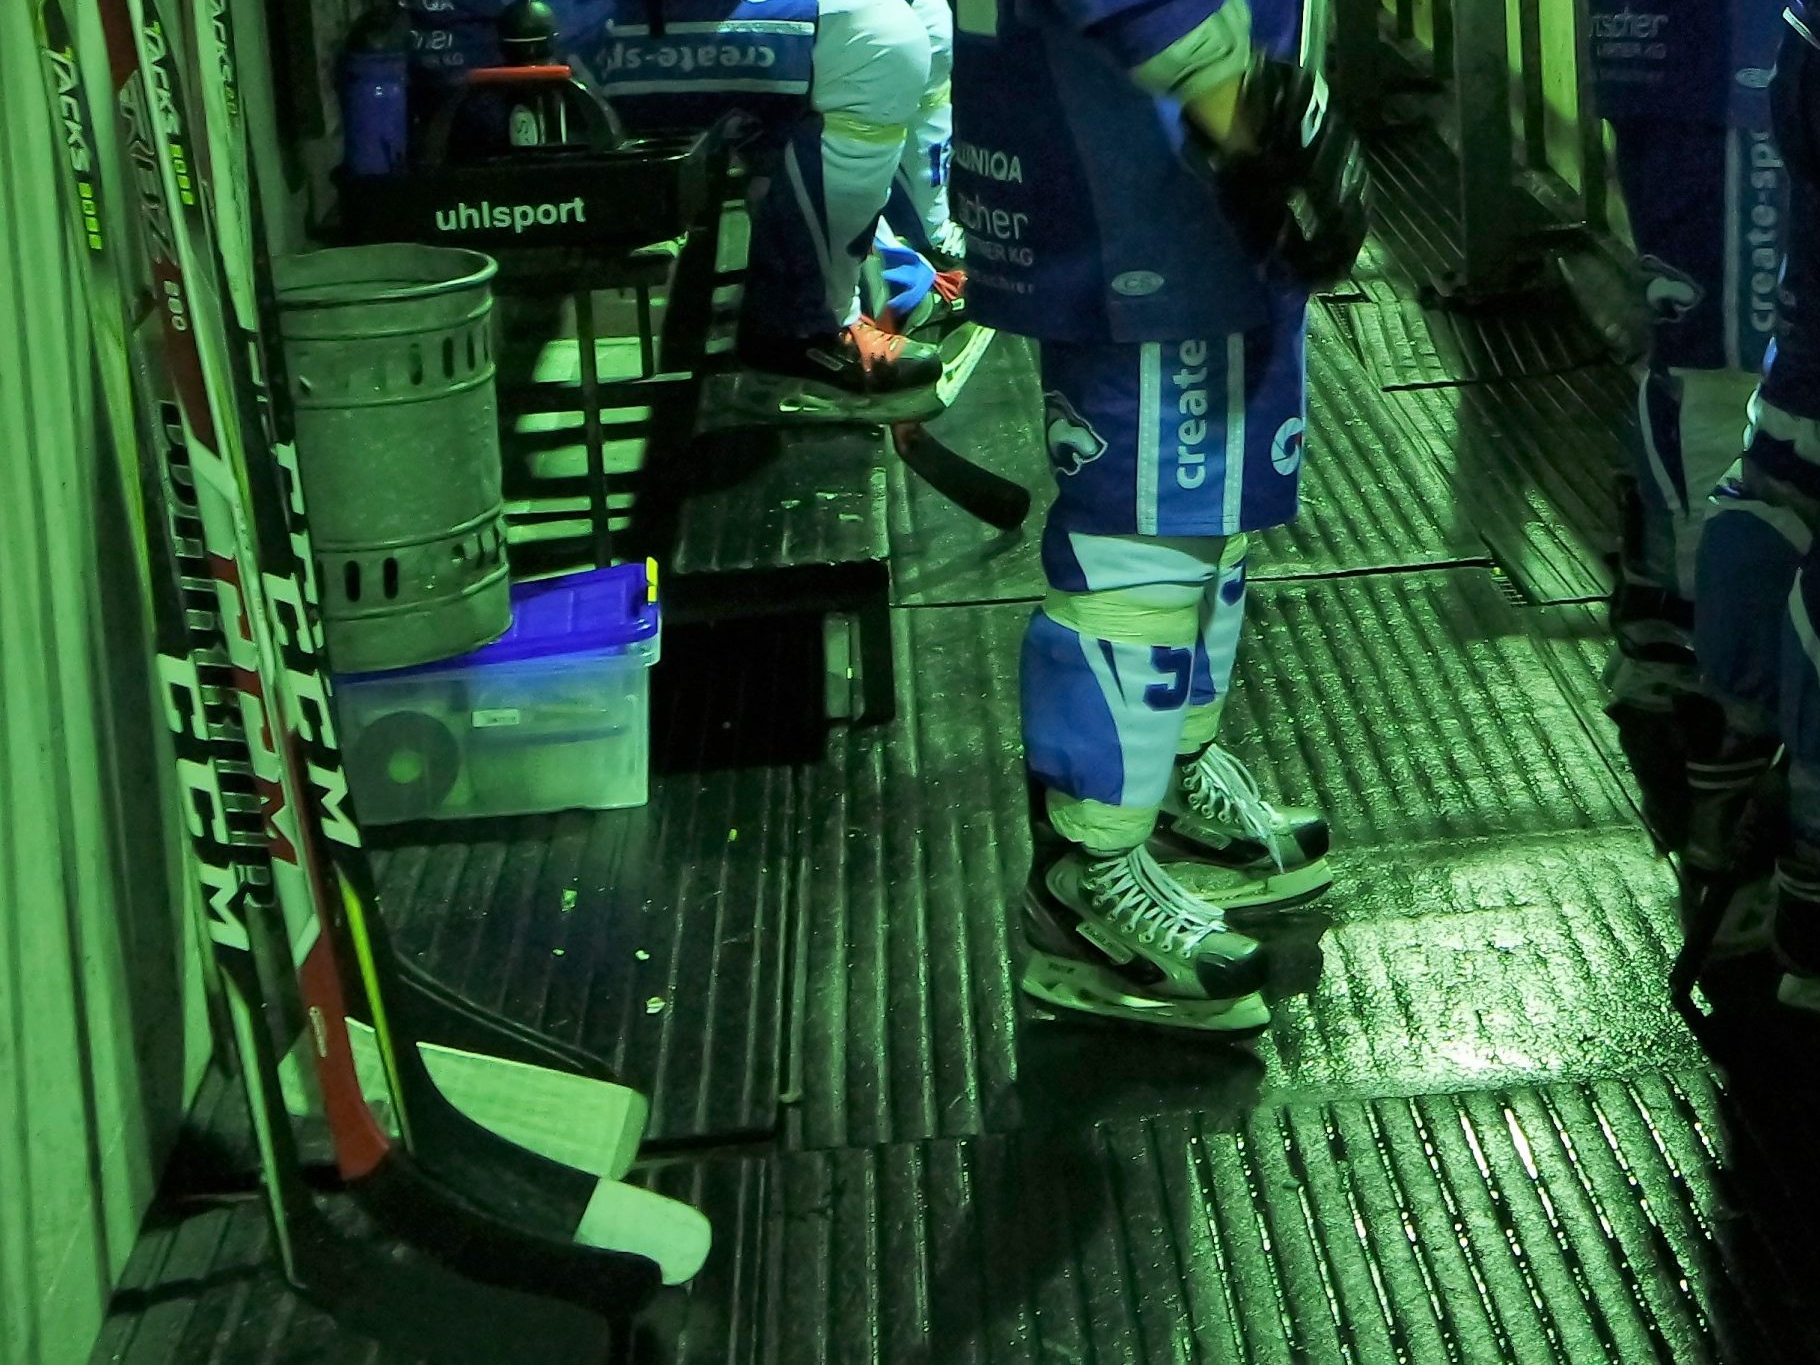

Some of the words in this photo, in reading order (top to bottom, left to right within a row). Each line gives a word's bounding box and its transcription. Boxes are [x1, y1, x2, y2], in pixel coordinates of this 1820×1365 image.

[40, 46, 91, 172] TACKS
[435, 196, 587, 234] uhlsport
[1172, 338, 1209, 490] create
[263, 568, 364, 850] CCM
[156, 651, 252, 951] CCM
